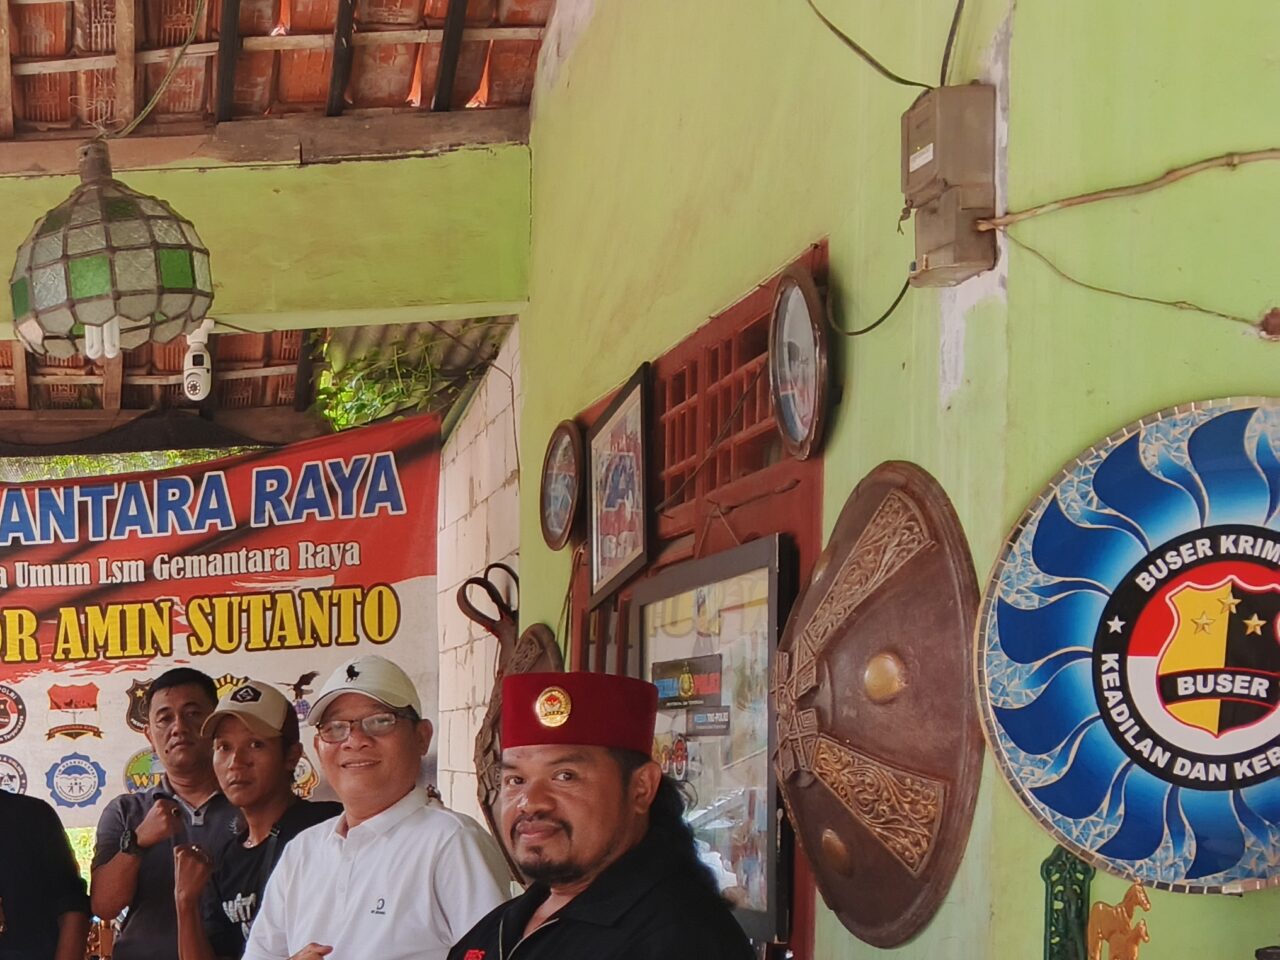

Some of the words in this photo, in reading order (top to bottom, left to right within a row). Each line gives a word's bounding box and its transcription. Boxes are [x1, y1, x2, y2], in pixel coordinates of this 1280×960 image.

[250, 451, 407, 528] RAYA
[14, 559, 91, 588] Umum
[98, 557, 145, 584] Lsm
[153, 547, 289, 580] Gemantara
[298, 541, 360, 570] Raya
[1135, 538, 1214, 592] BUSER
[1221, 535, 1280, 565] KRIM
[54, 599, 174, 662] AMIN
[186, 583, 401, 655] SUTANTO
[1101, 653, 1172, 769] KEADILAN
[1173, 756, 1227, 781] DAN
[1177, 674, 1270, 697] BUSER
